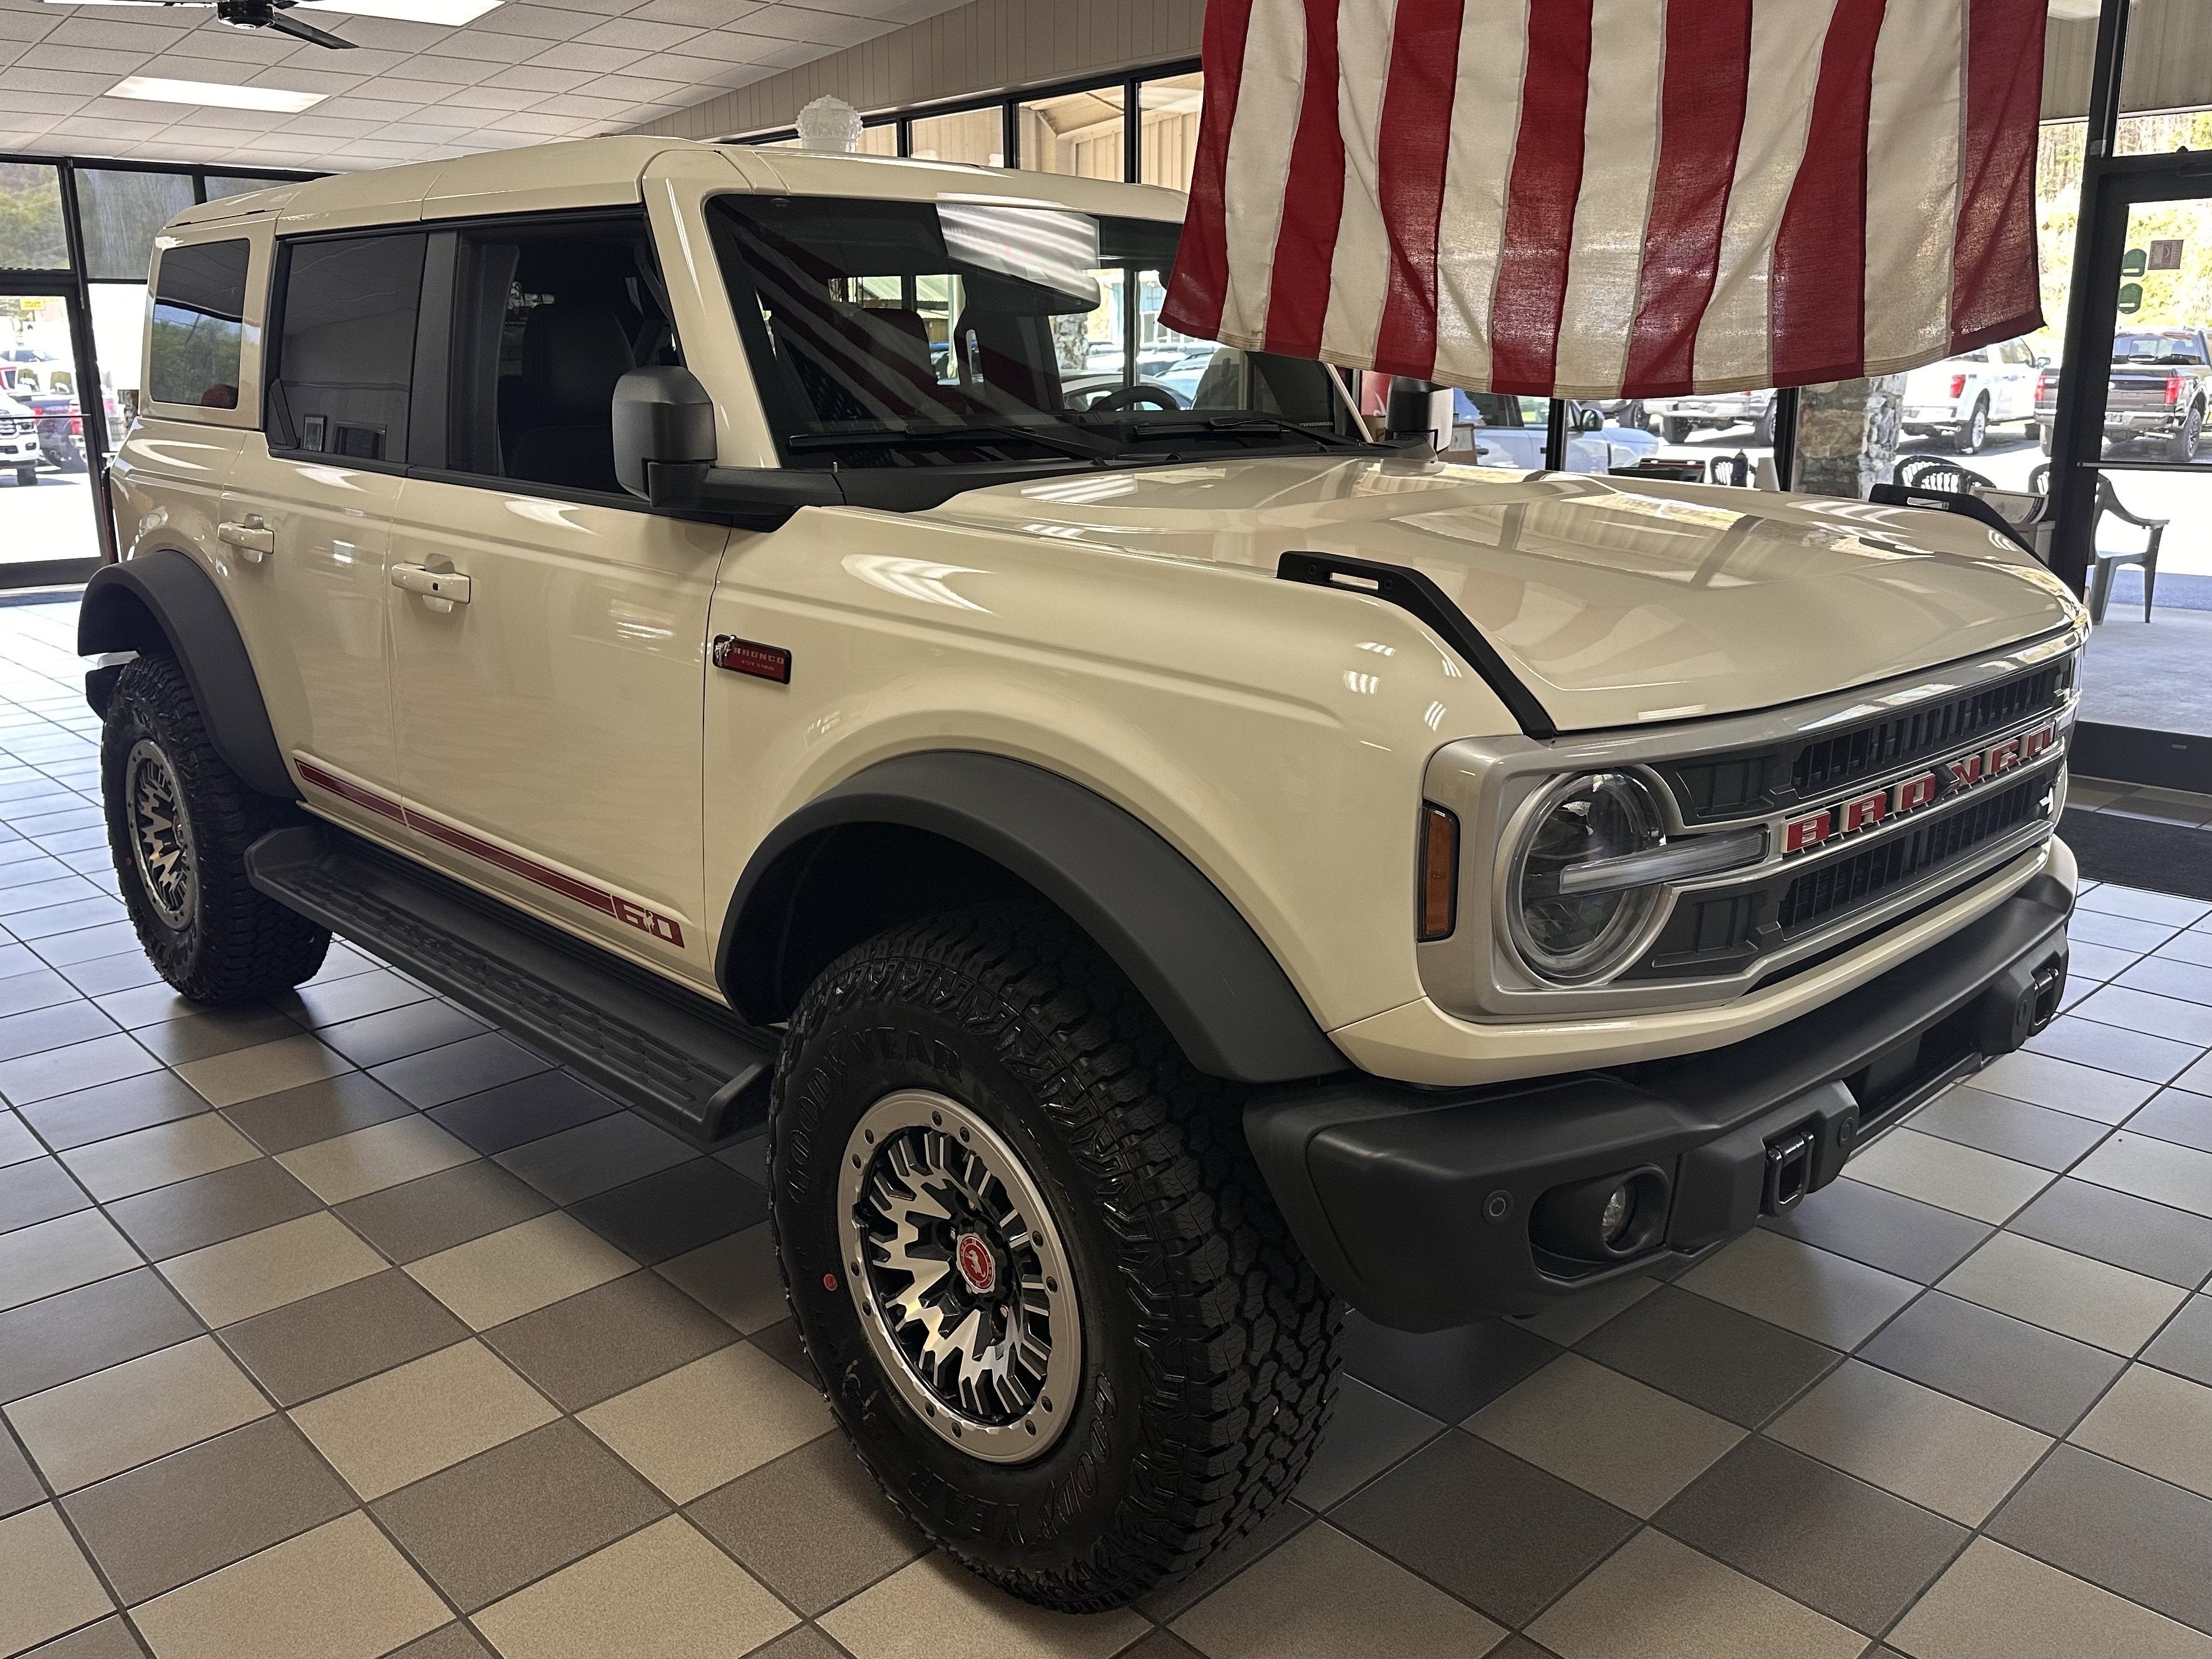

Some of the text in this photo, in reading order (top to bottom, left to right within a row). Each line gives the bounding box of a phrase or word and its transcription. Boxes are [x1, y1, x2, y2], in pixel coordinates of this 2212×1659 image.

[734, 647, 784, 664] BRONCO
[1781, 722, 2052, 853] BRONCO
[612, 895, 685, 949] 60
